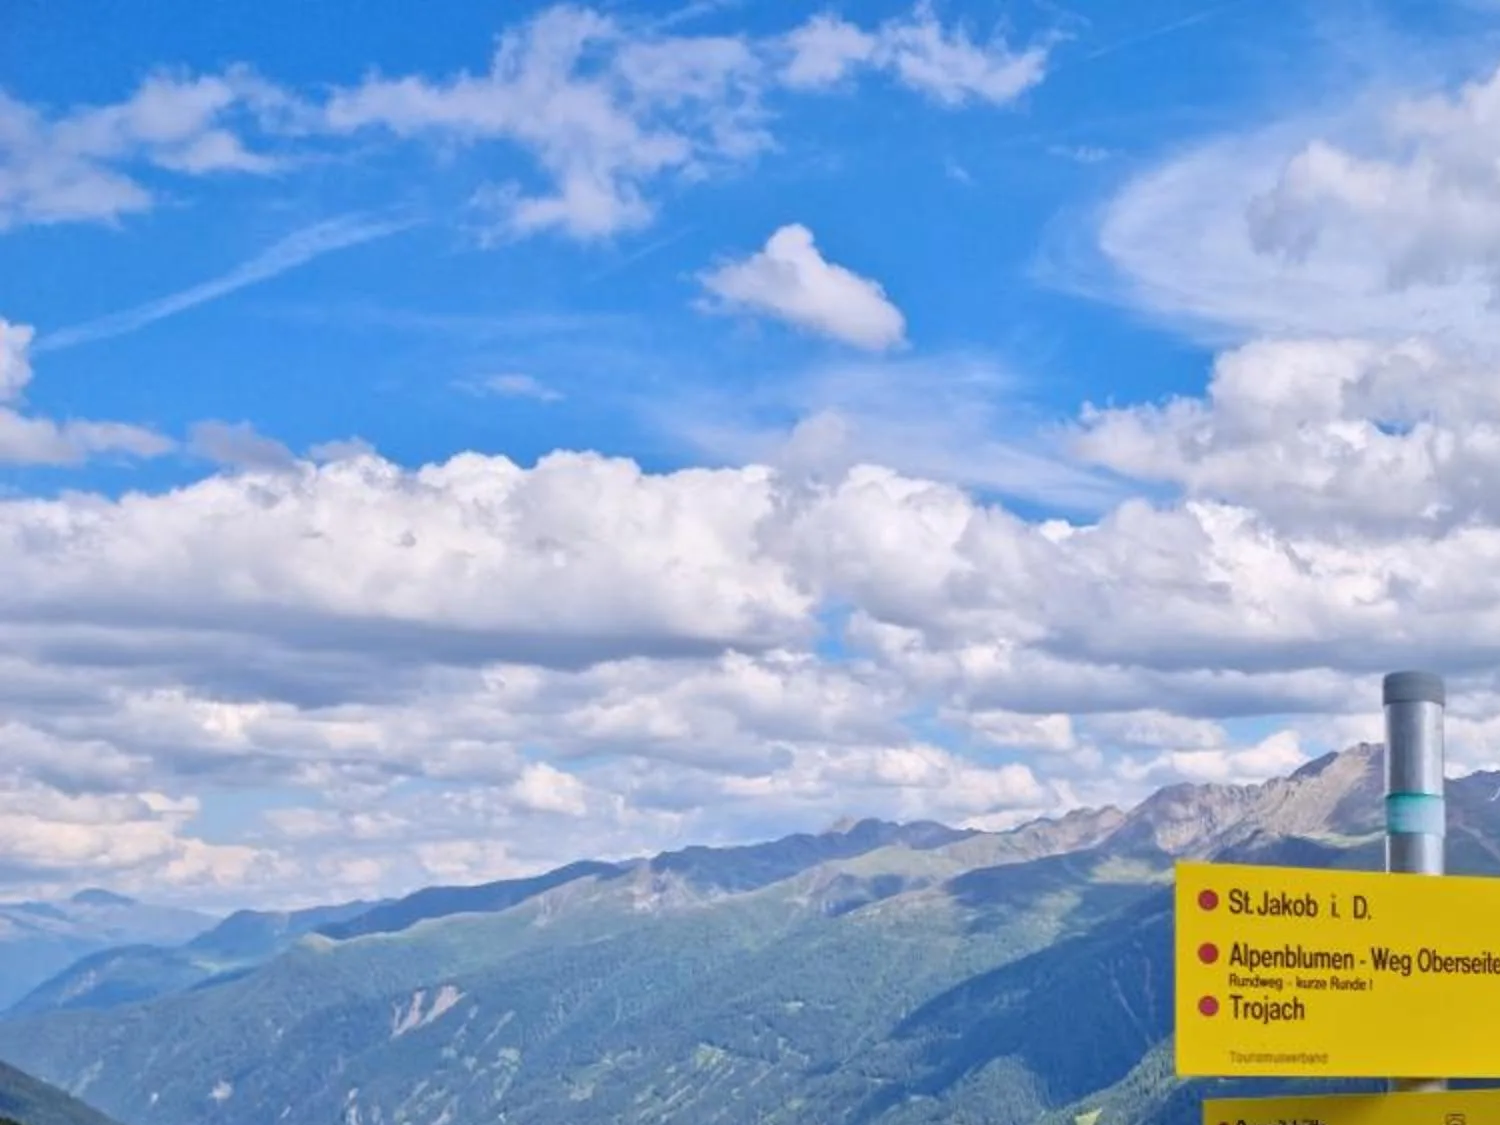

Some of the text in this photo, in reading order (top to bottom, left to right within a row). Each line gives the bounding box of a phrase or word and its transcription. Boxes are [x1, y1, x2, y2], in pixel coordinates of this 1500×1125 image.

[1353, 896, 1372, 919] D.
[1229, 942, 1354, 972] Alpenblumen
[1371, 948, 1412, 976] Weg
[1229, 973, 1283, 990] Rundweg
[1296, 976, 1327, 990] kurze
[1330, 976, 1367, 991] Runde
[1230, 995, 1305, 1024] Trojach
